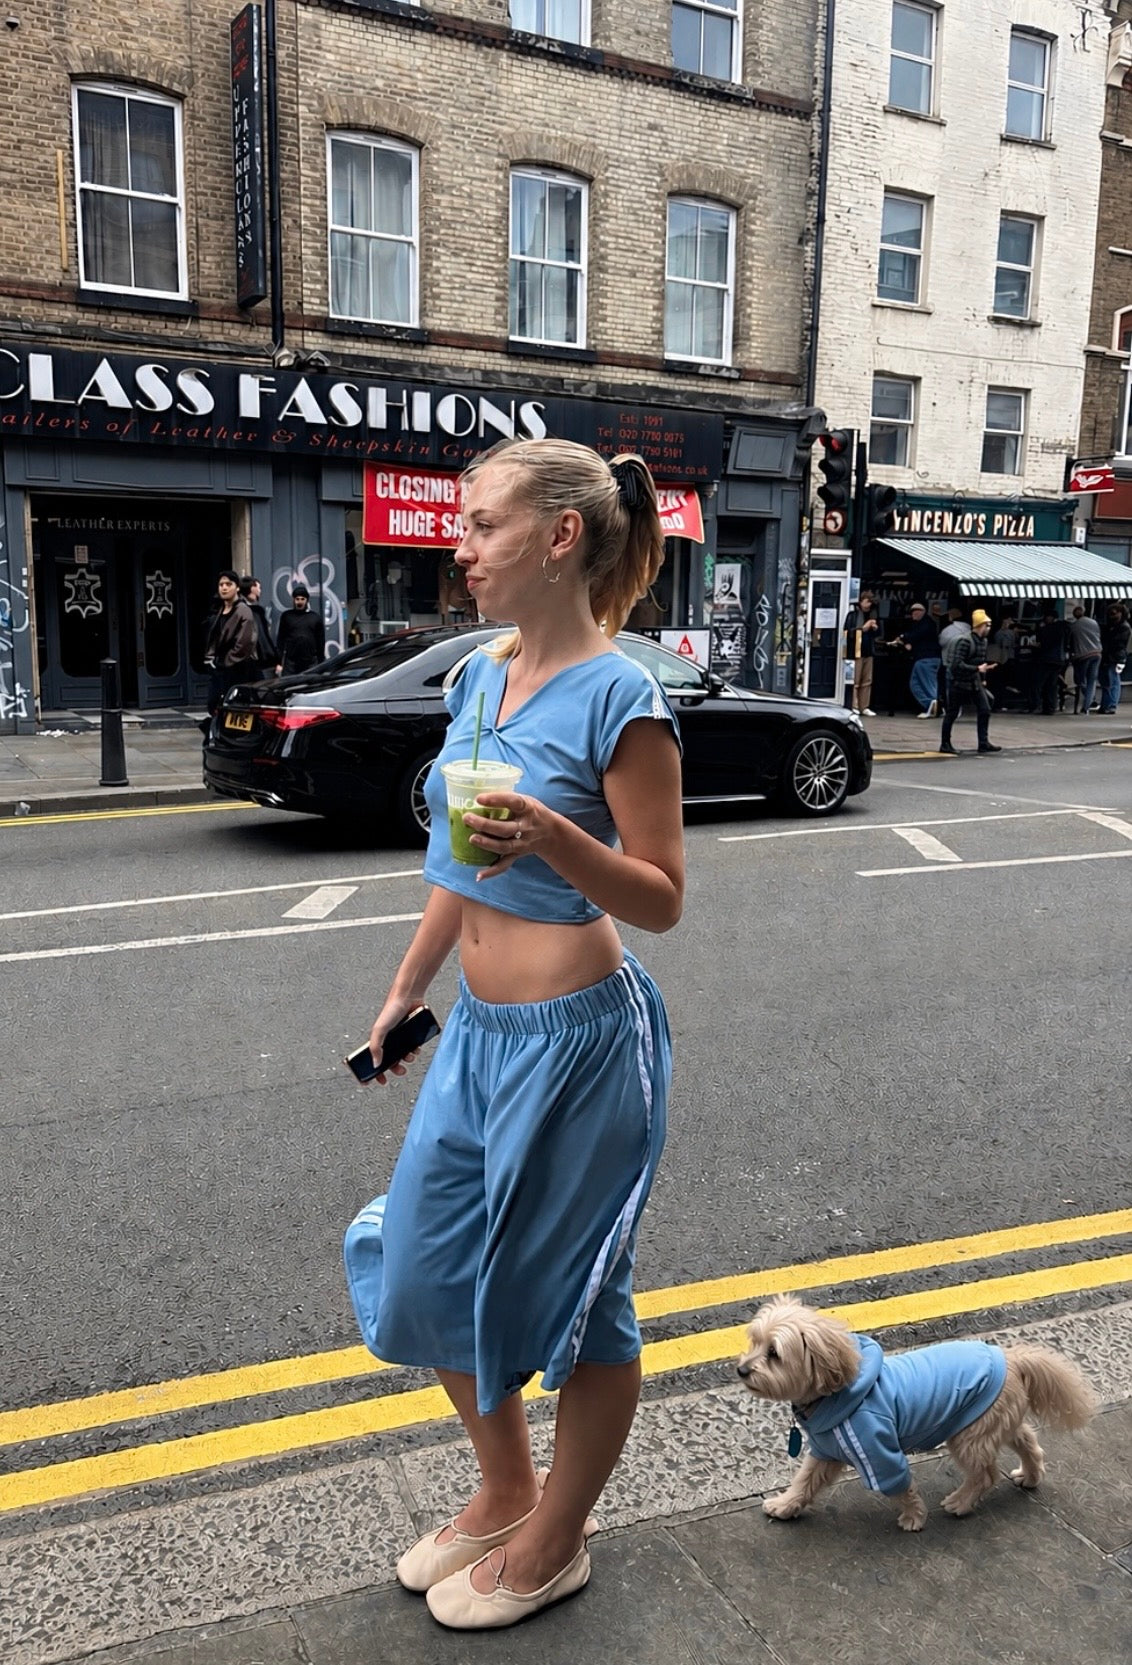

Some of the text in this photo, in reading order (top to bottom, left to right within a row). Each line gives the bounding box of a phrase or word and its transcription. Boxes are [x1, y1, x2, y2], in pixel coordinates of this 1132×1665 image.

[238, 372, 548, 441] FASHIONS
[106, 420, 135, 436] of
[151, 421, 258, 442] Leather
[272, 427, 296, 443] &
[309, 432, 431, 457] Sheepskin
[375, 471, 456, 505] CLOSING
[56, 518, 171, 531] LEATHER EXPERTS
[388, 508, 436, 538] HUGE
[892, 508, 1035, 538] VINCENZO'S PIZZA
